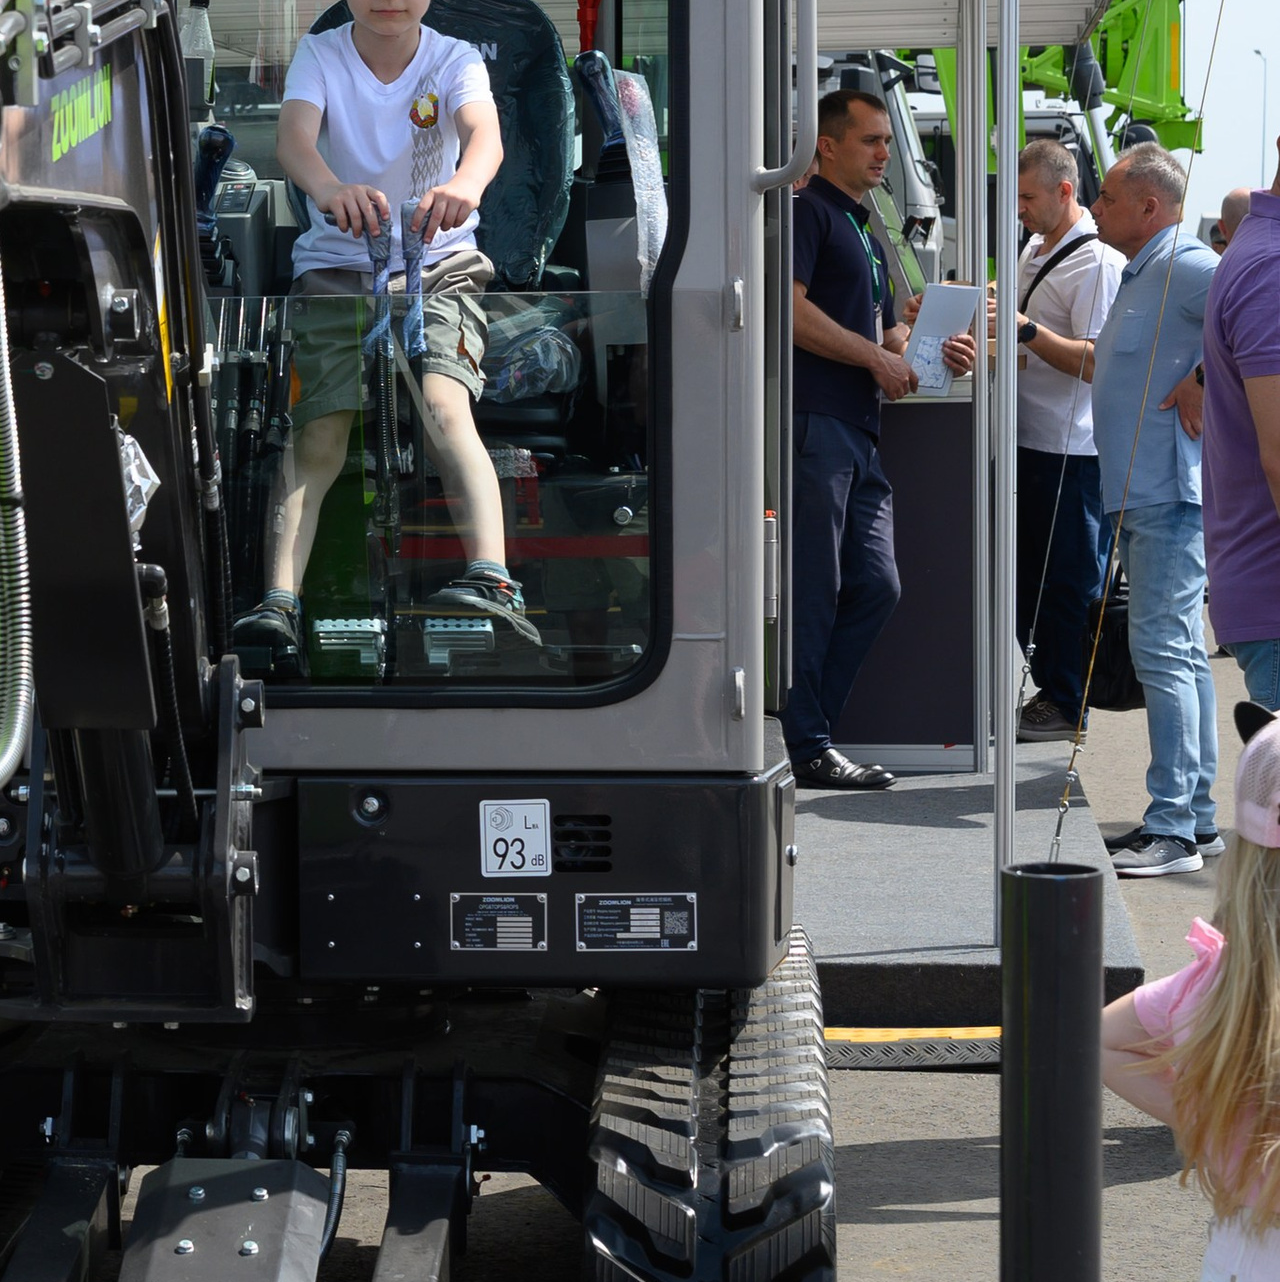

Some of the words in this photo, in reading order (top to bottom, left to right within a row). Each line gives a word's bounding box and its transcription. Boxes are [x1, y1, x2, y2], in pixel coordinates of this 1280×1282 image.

[51, 62, 112, 163] ZOOMLION
[492, 837, 526, 870] 93
[530, 854, 545, 866] dB
